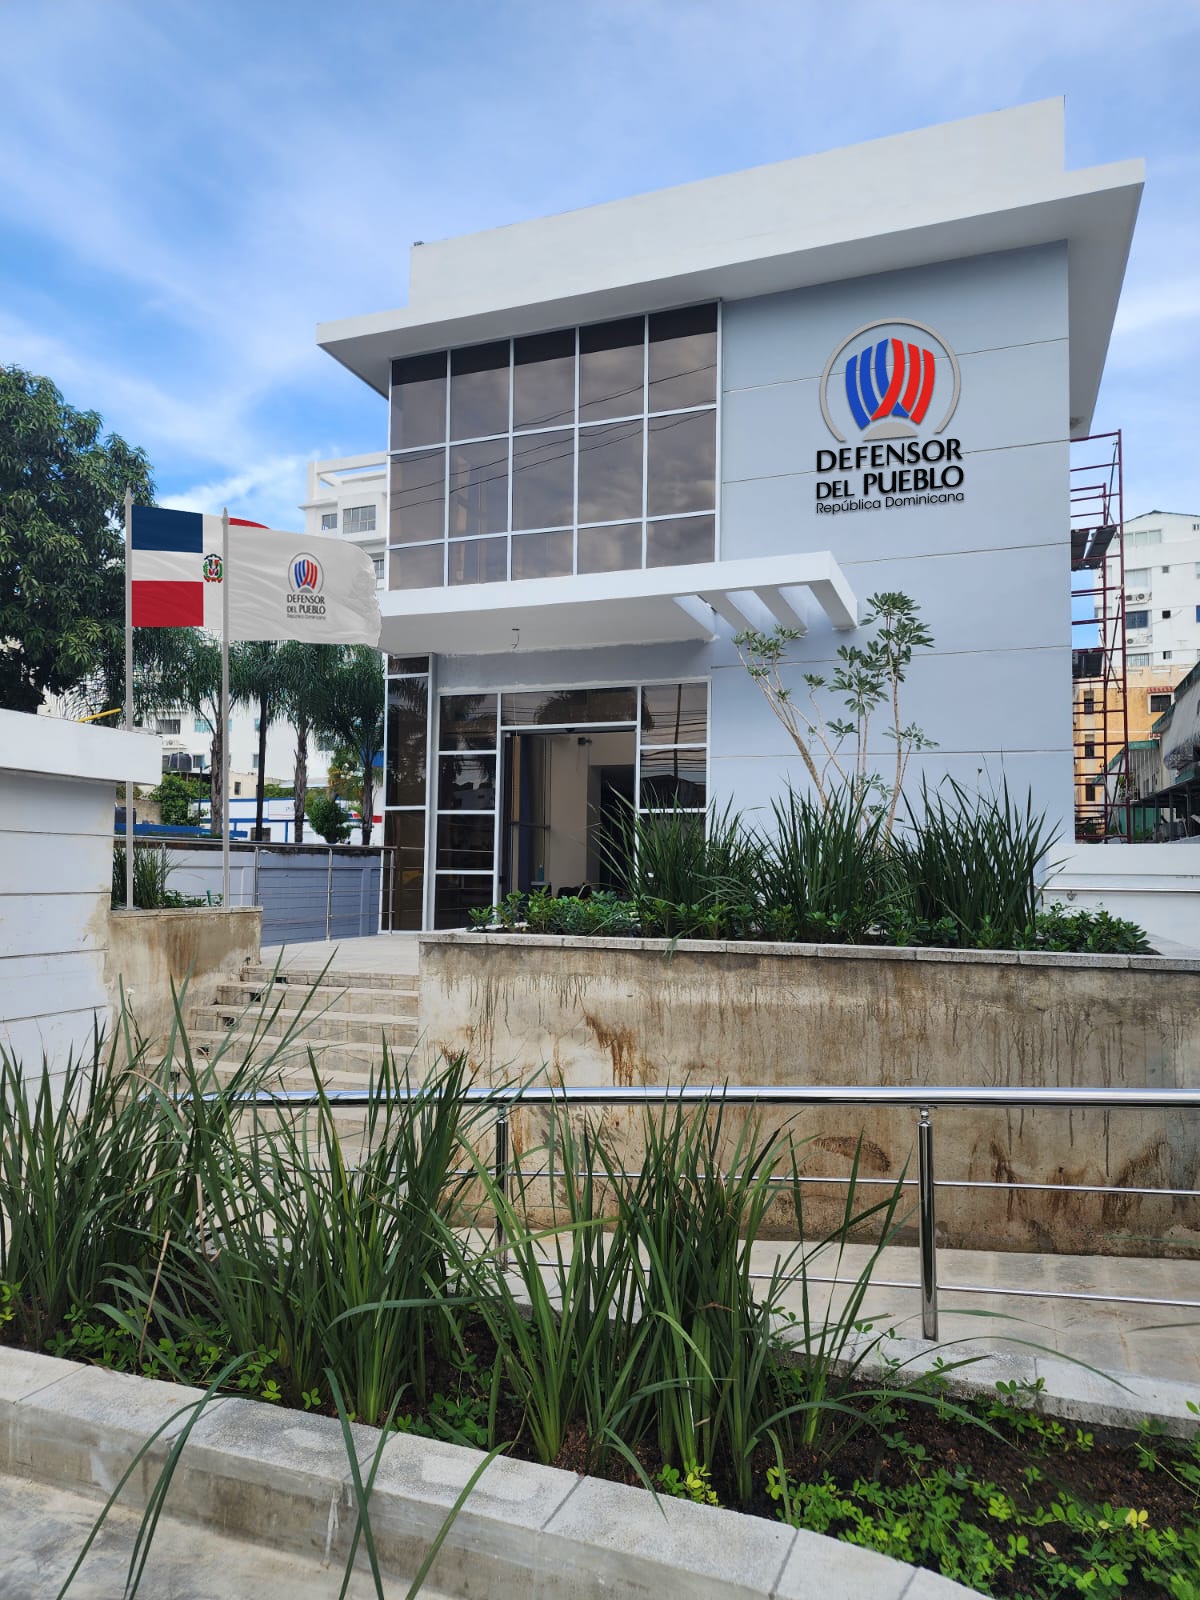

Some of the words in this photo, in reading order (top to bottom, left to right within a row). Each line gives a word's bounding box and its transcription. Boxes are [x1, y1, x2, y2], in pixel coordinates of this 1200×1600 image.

[816, 438, 963, 472] DEFENSOR
[816, 480, 855, 499] DEL
[863, 465, 964, 495] PUEBLO
[816, 499, 881, 514] República
[885, 492, 964, 507] Dominicana
[287, 594, 325, 604] DEFENSOR
[287, 605, 297, 613] DEL
[299, 604, 326, 614] PUEBLO
